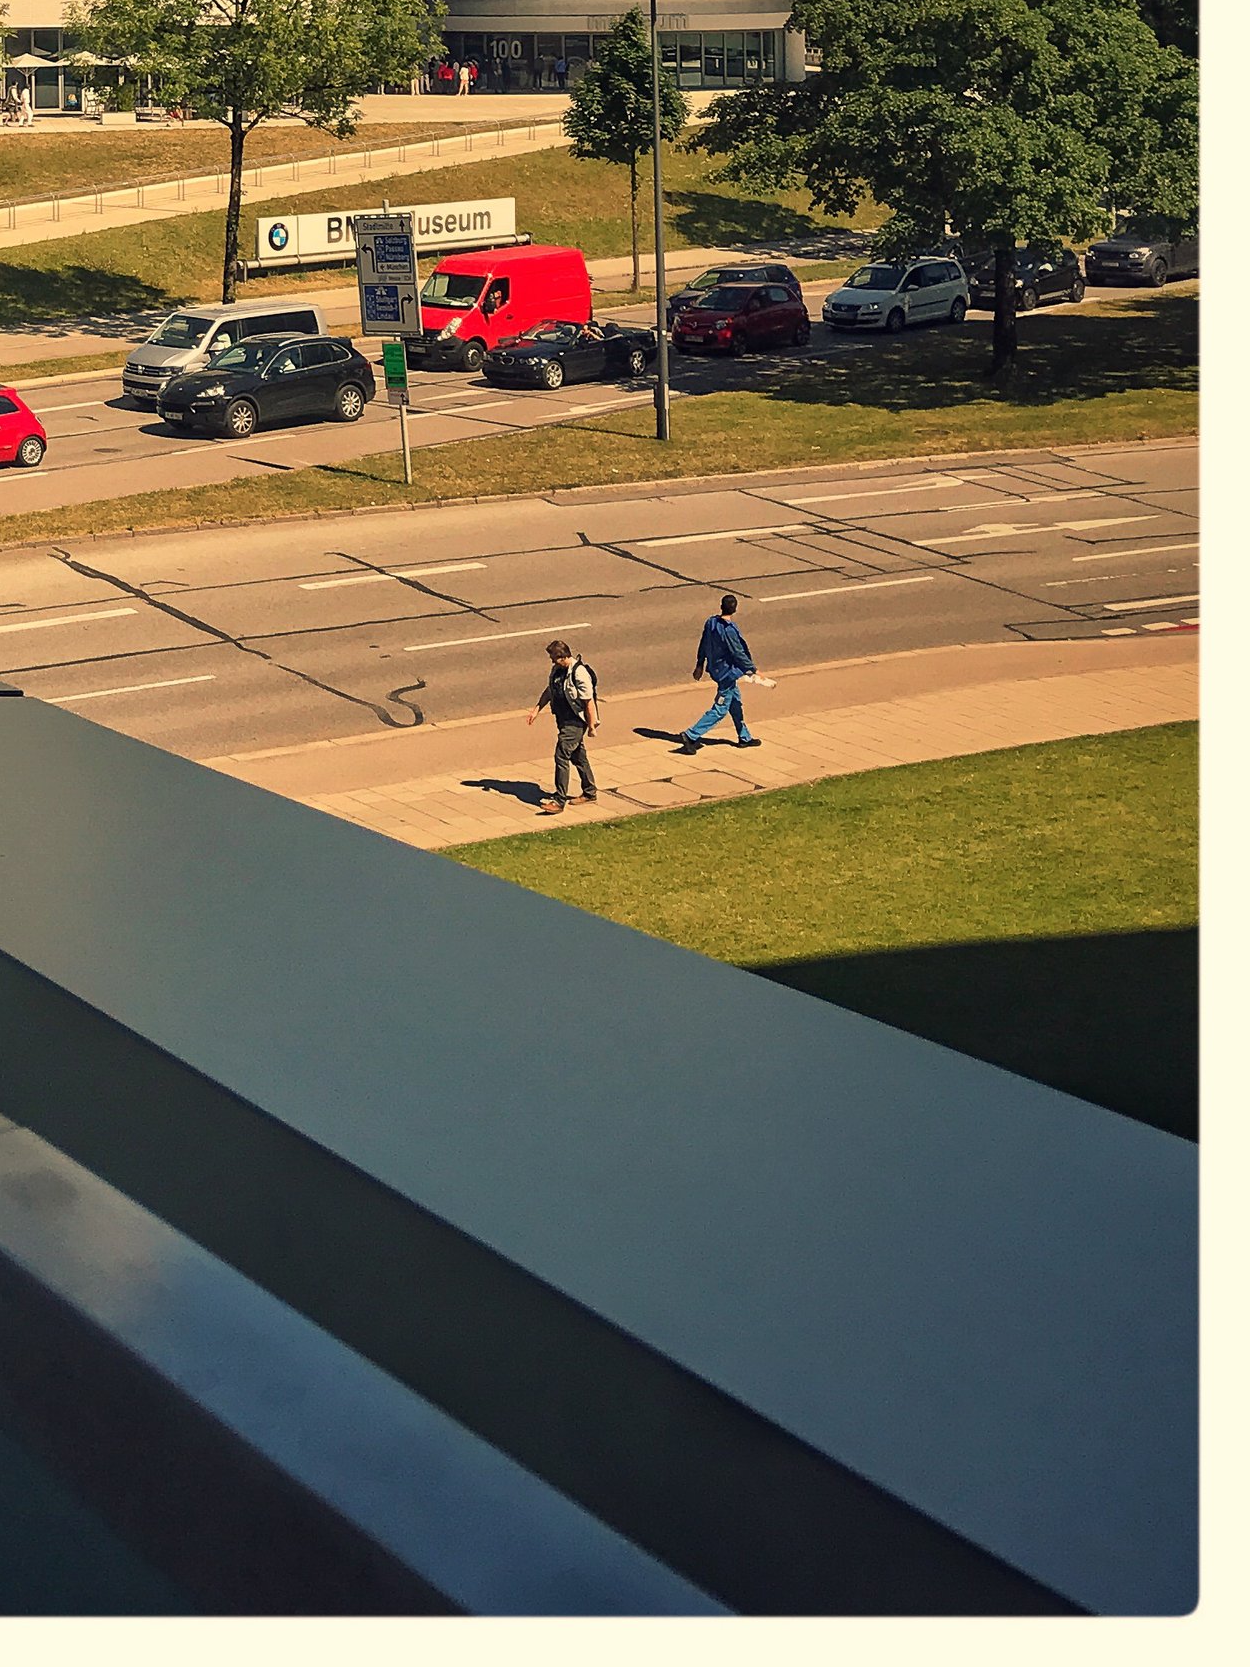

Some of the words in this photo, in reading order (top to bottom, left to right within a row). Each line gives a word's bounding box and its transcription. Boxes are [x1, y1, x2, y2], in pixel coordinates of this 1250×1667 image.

[489, 40, 523, 59] 100
[362, 222, 394, 231] Stadtmitte
[414, 210, 492, 237] useum
